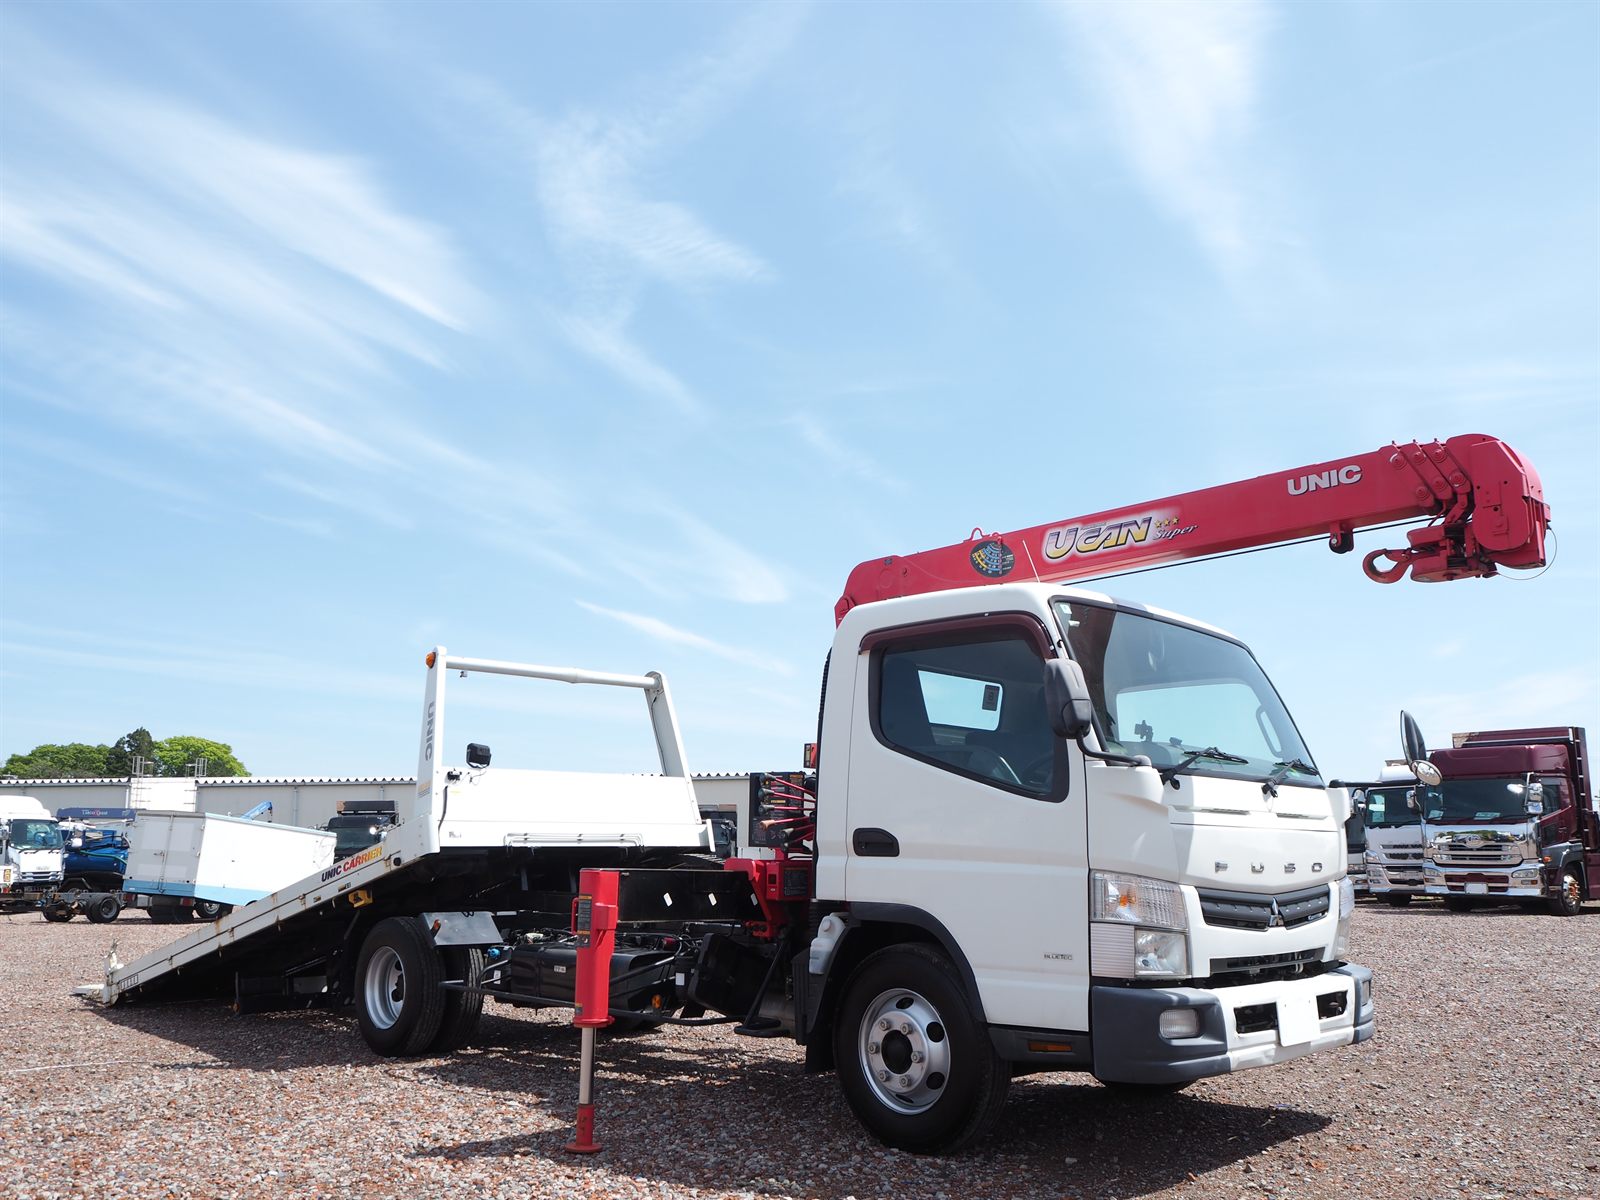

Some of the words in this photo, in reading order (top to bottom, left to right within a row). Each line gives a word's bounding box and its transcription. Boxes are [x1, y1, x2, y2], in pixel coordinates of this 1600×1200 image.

[1287, 465, 1363, 497] UNIC
[1045, 516, 1152, 560] UCAN
[1153, 524, 1198, 541] Super
[425, 701, 435, 761] UNIC
[321, 865, 342, 882] UNIC
[342, 847, 383, 872] CARRIER
[1214, 861, 1323, 874] FUSO
